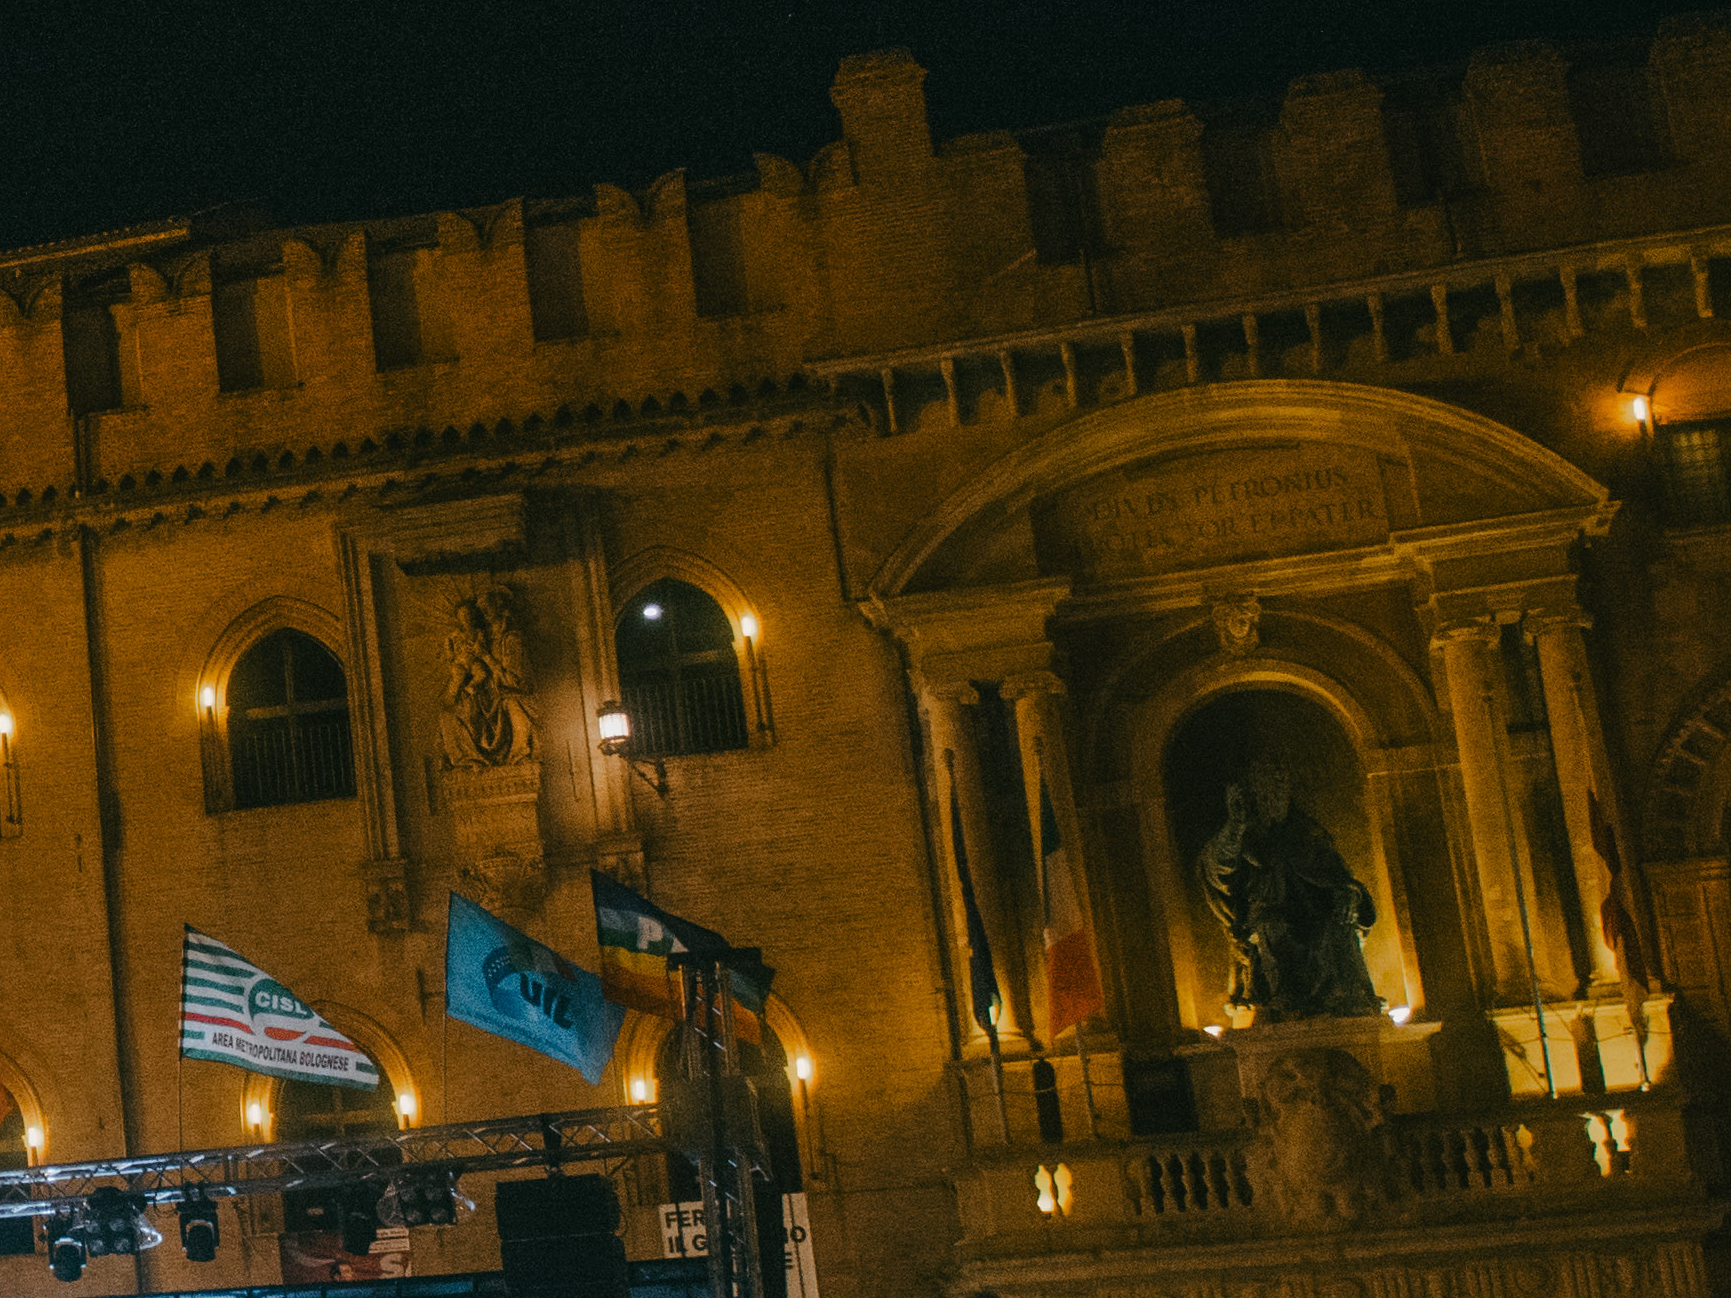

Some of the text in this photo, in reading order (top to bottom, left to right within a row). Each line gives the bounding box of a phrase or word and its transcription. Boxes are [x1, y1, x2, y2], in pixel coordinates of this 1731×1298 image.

[254, 991, 308, 1016] CISL
[520, 972, 575, 1030] UIL
[211, 1032, 350, 1072] AREA METROPOLITANA BOLOGNESE
